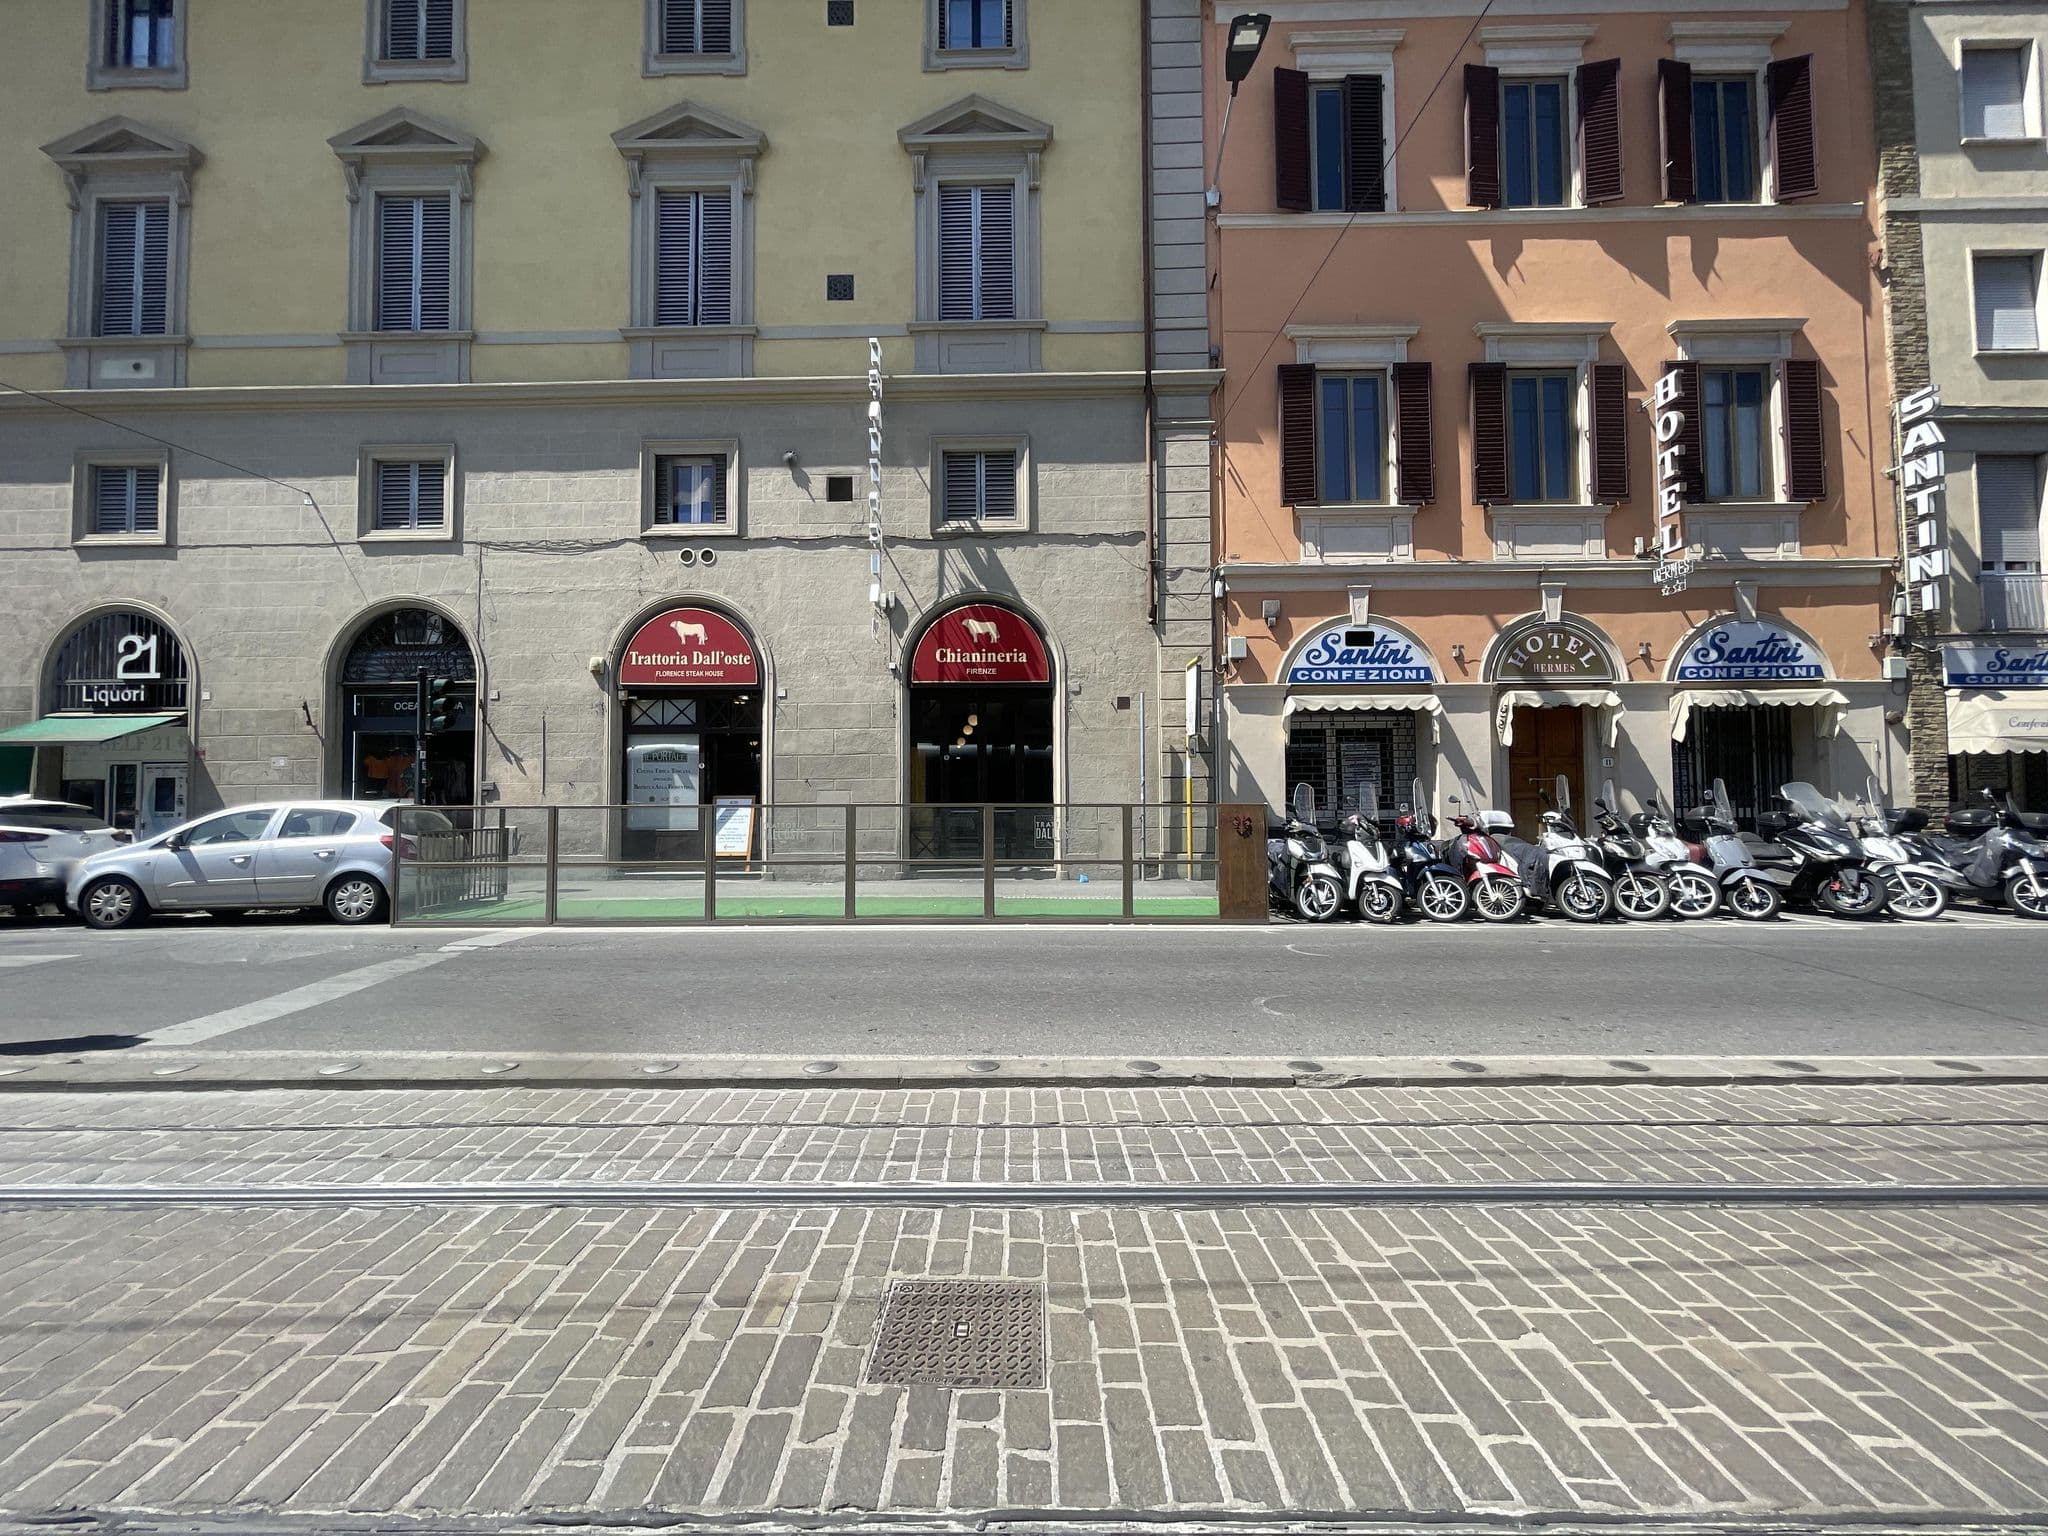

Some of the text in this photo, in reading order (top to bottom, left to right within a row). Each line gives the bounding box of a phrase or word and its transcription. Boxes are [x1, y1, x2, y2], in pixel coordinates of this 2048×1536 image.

[1655, 369, 1686, 556] HOTEL
[1901, 384, 1949, 612] SANTINI
[1653, 560, 1690, 583] HERMES
[117, 635, 160, 679] 21
[630, 651, 751, 665] Trattoria Dall'oste
[935, 648, 1027, 663] Chianineria
[1306, 633, 1413, 666] Santini
[1508, 633, 1596, 668] HOTEL
[1693, 631, 1803, 664] Santini
[1296, 669, 1425, 680] CONFEZIONI
[1533, 663, 1576, 672] HERMES
[1684, 666, 1815, 678] CONFEZIONI
[82, 684, 145, 707] Liquori
